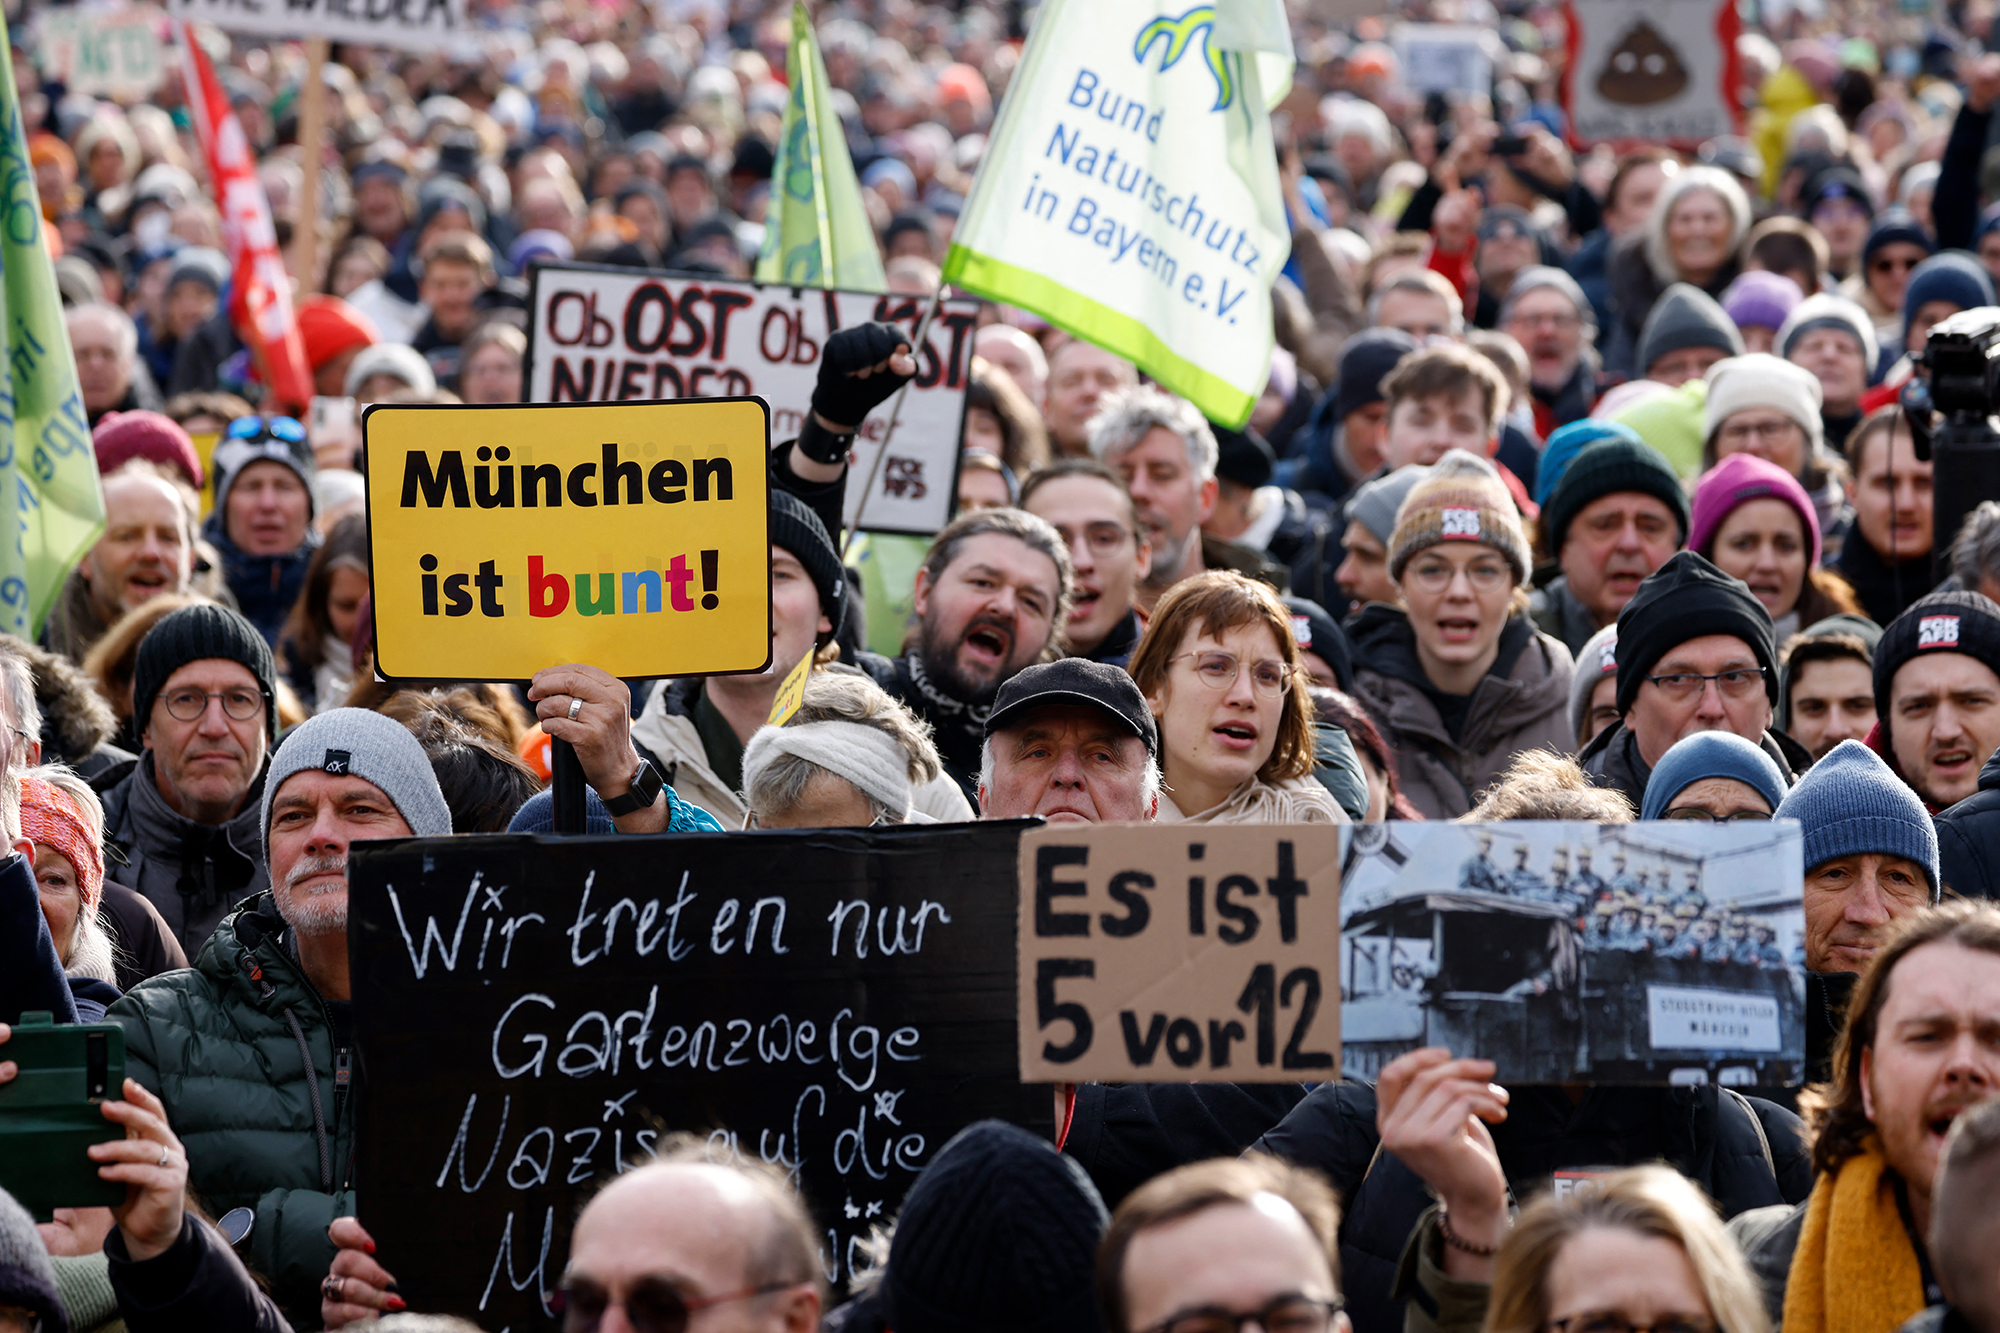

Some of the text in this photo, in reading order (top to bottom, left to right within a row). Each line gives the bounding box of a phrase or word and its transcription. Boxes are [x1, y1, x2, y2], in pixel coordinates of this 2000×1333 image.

[1067, 68, 1166, 145] Bund
[1023, 173, 1247, 326] in Bayern e.V.
[1045, 121, 1261, 276] Naturschutz
[548, 290, 615, 348] Ob
[623, 276, 755, 361] OST
[760, 304, 820, 366] Ob
[400, 442, 734, 510] München
[419, 549, 720, 618] ist bunt!
[1919, 617, 1960, 633] FCK
[1919, 629, 1959, 645] AFD
[386, 869, 953, 979] Wir treten nur
[1036, 840, 1310, 945] Es ist
[492, 984, 930, 1092] Gartenzwerge
[1035, 957, 1096, 1064] 5
[435, 1084, 928, 1195] Nazis auf die
